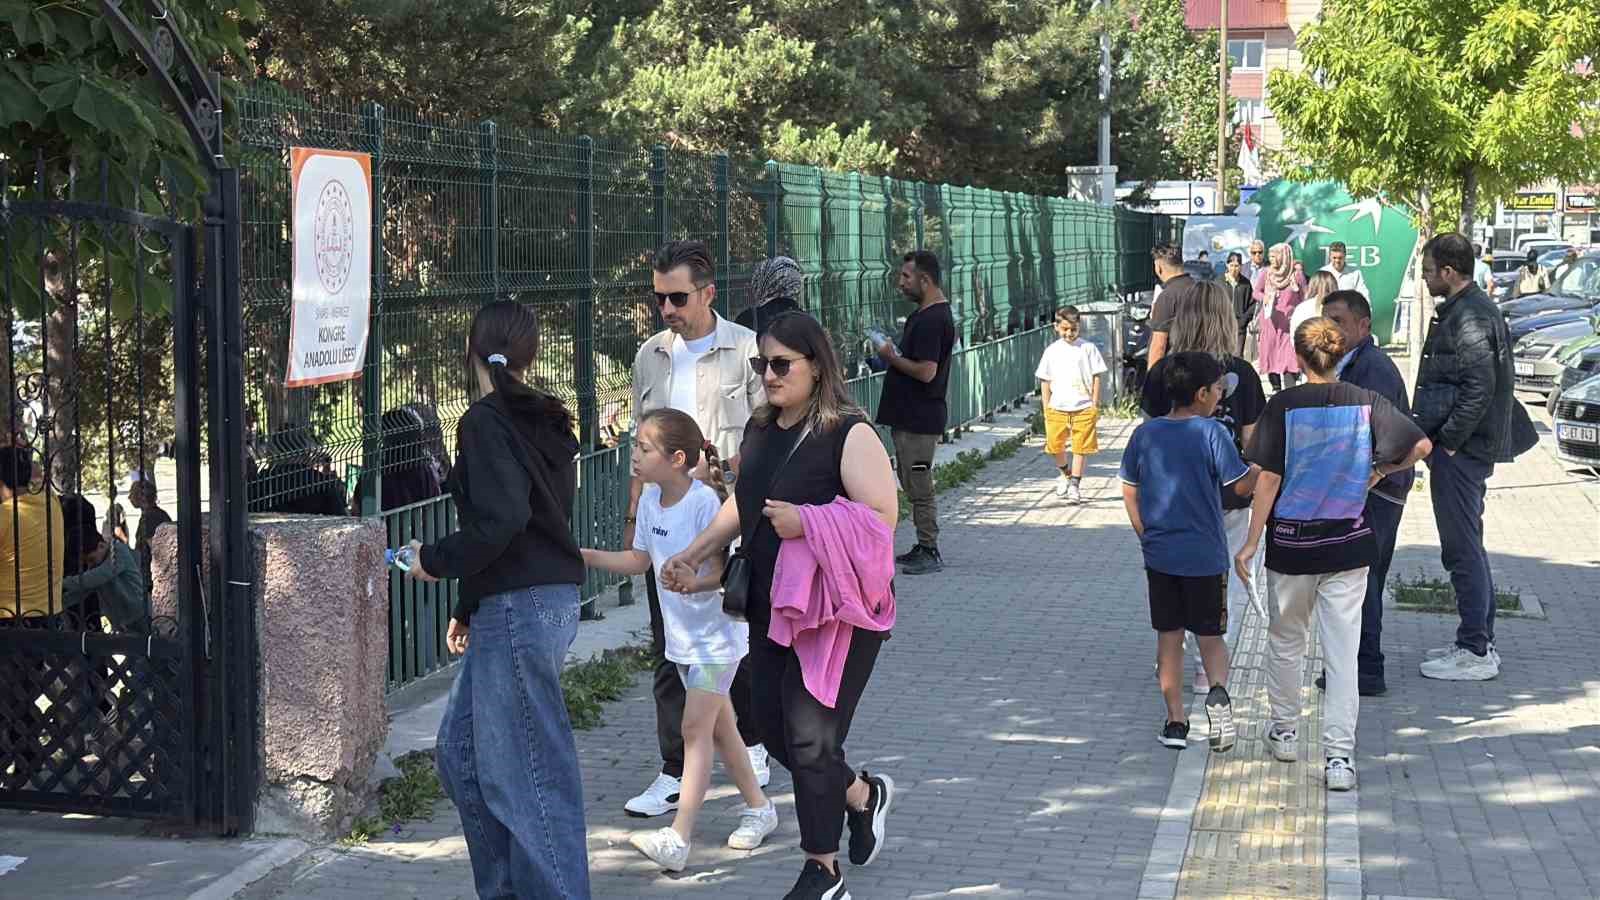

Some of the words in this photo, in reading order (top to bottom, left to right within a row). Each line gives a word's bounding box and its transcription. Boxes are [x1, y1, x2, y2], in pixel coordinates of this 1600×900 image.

[1318, 245, 1381, 267] TEB
[318, 324, 346, 343] KONGRE
[303, 347, 338, 369] ANADOLU
[338, 343, 357, 363] LİSESİ
